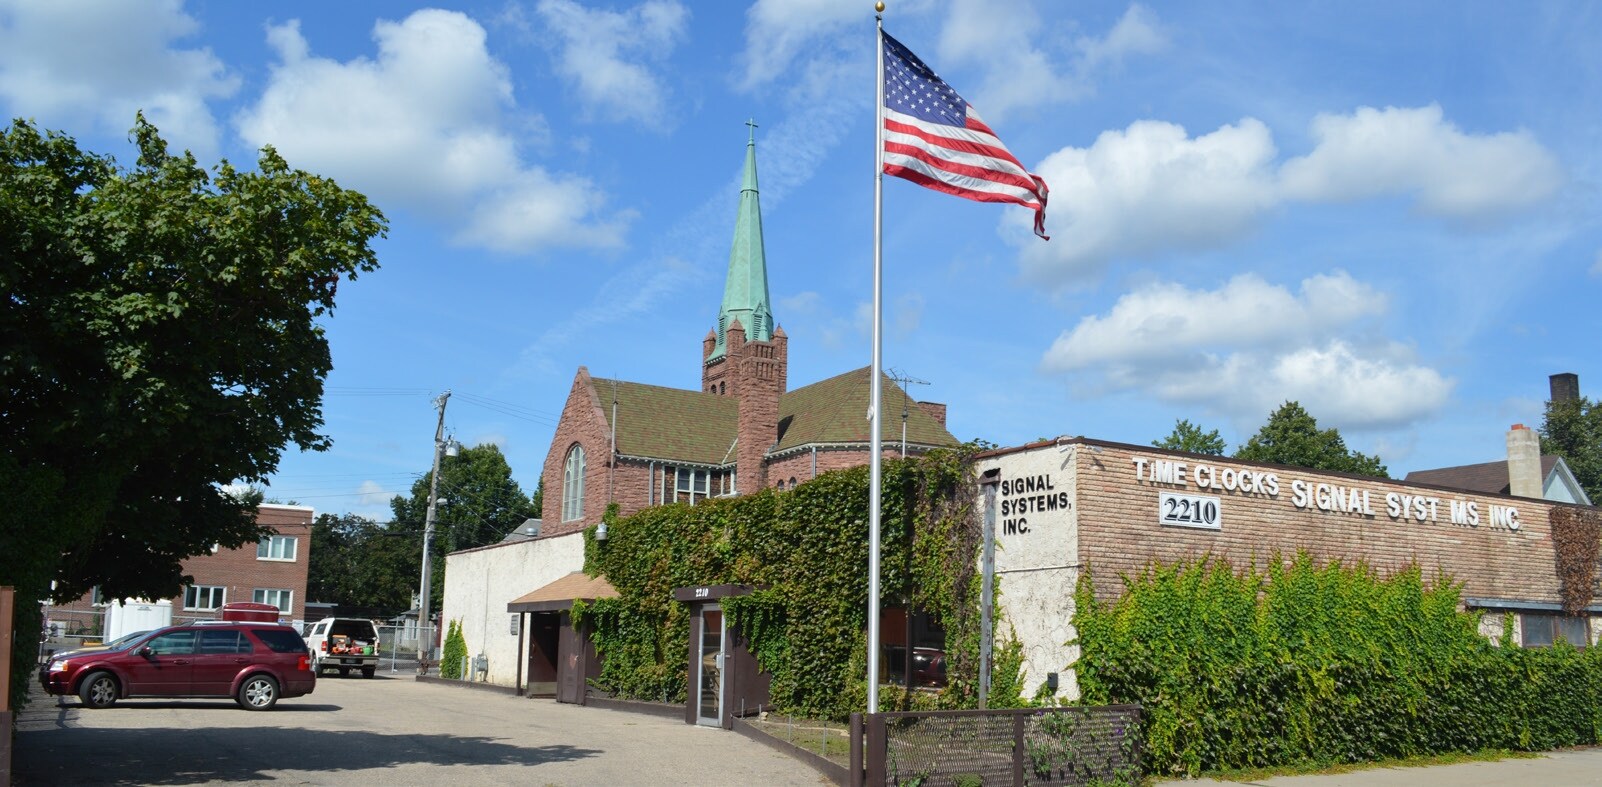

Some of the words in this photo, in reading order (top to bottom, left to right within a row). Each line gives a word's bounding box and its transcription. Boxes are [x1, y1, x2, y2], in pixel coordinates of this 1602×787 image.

[1001, 474, 1054, 496] SIGNAL
[1132, 457, 1187, 485] TIME
[1194, 464, 1279, 496] CLOCKS
[1292, 480, 1375, 516] SIGNAL
[1001, 492, 1072, 516] SYSTEMS,
[1164, 497, 1217, 525] 2210
[1003, 518, 1031, 535] INC.
[695, 588, 709, 597] 2210
